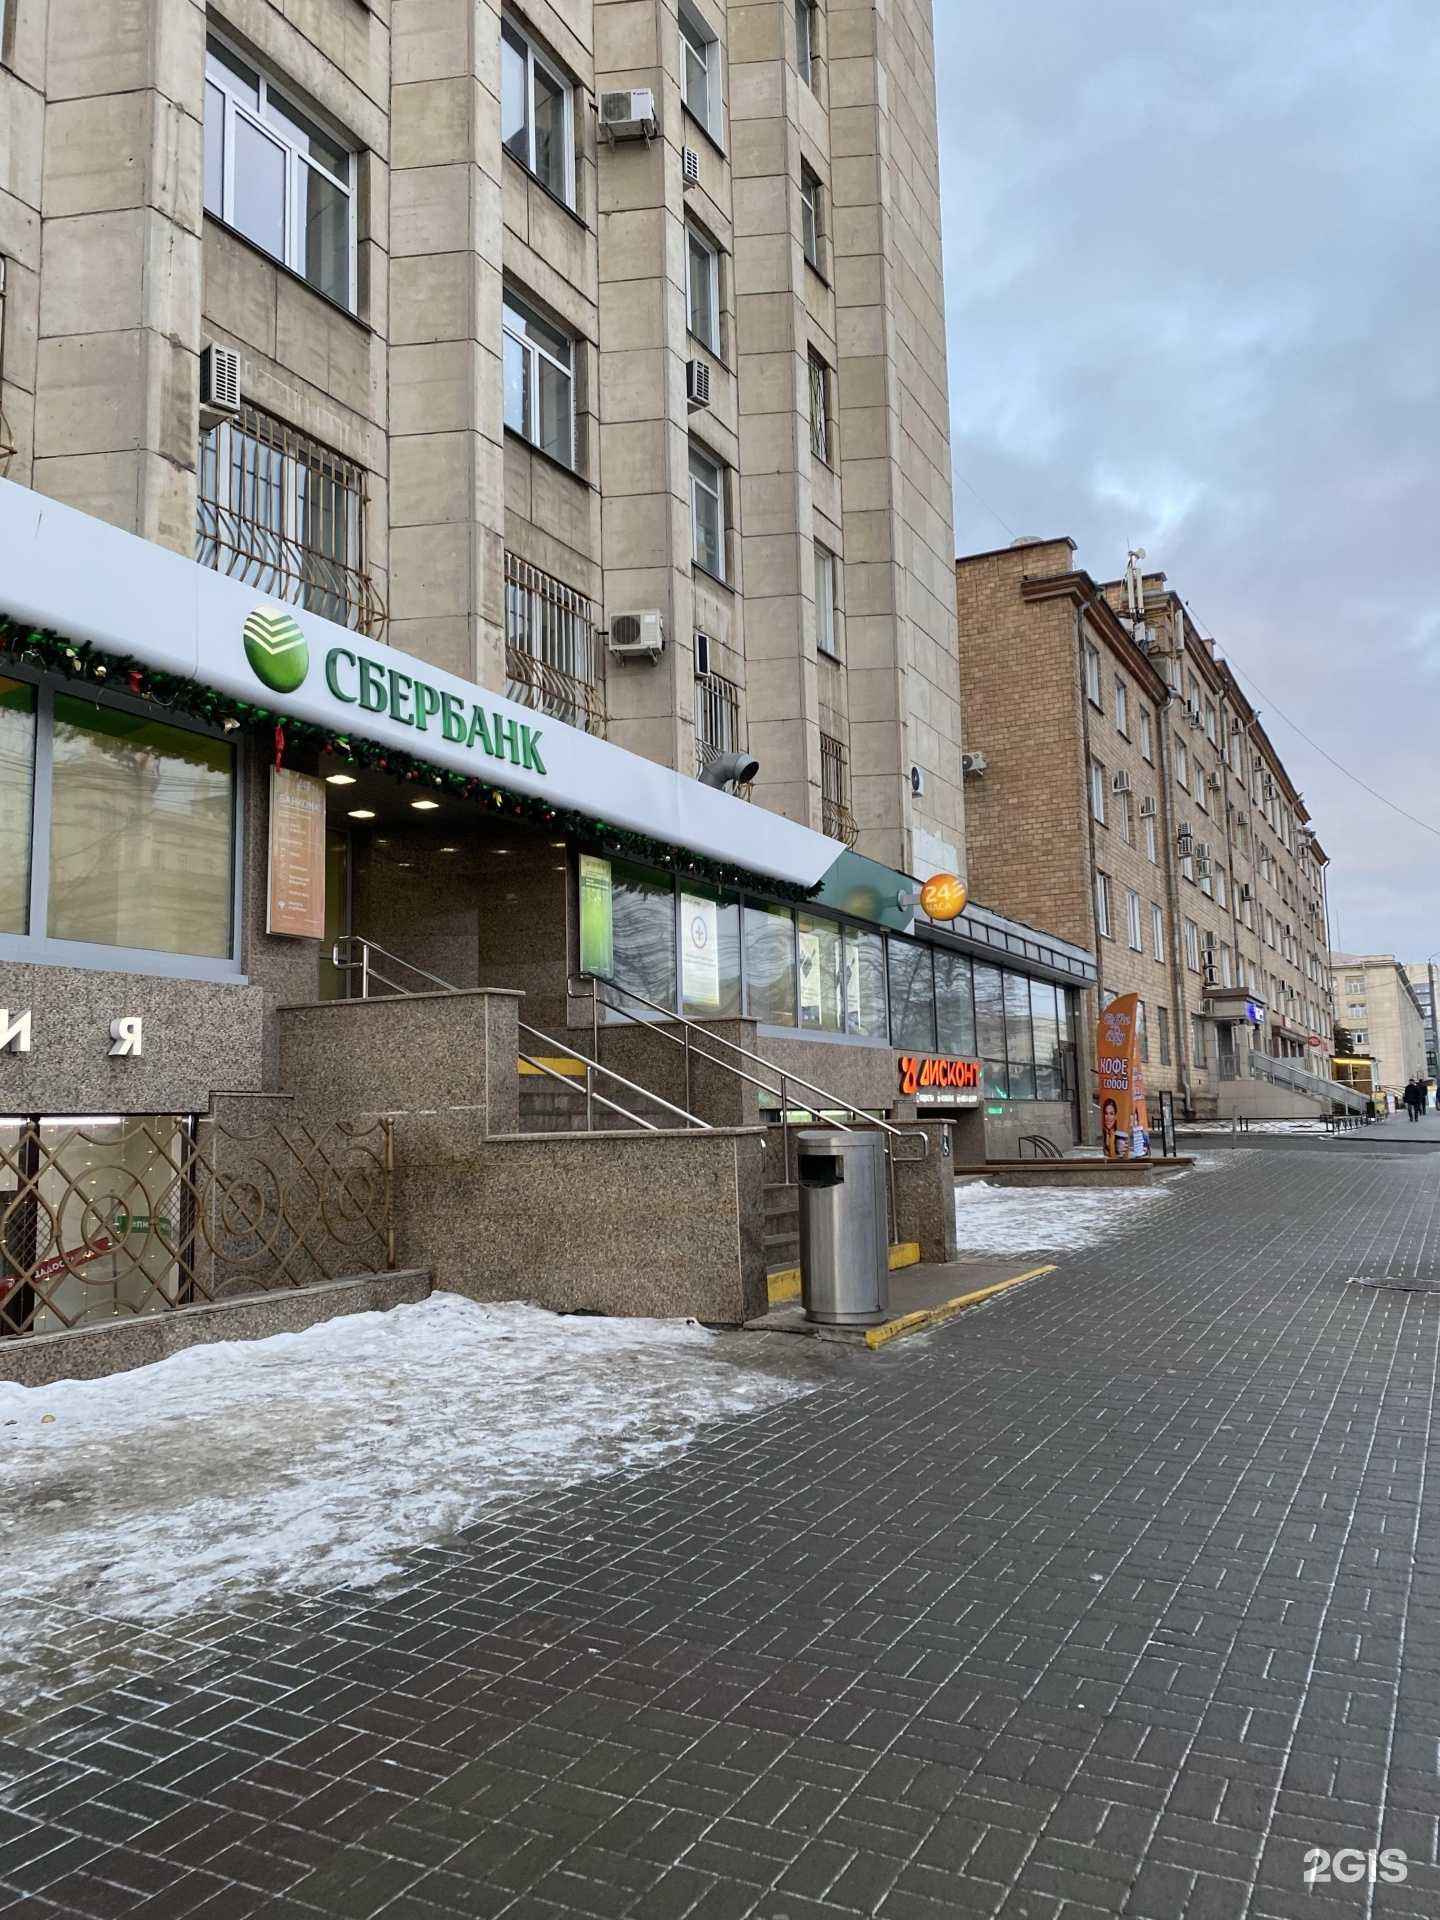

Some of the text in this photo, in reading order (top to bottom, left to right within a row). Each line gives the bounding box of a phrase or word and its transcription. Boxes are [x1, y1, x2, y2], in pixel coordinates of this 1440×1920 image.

[325, 647, 547, 775] СБЕРБАНК
[926, 884, 951, 903] 24
[920, 1058, 981, 1087] ДИСКОНТ
[1100, 1057, 1128, 1076] КОФЕ
